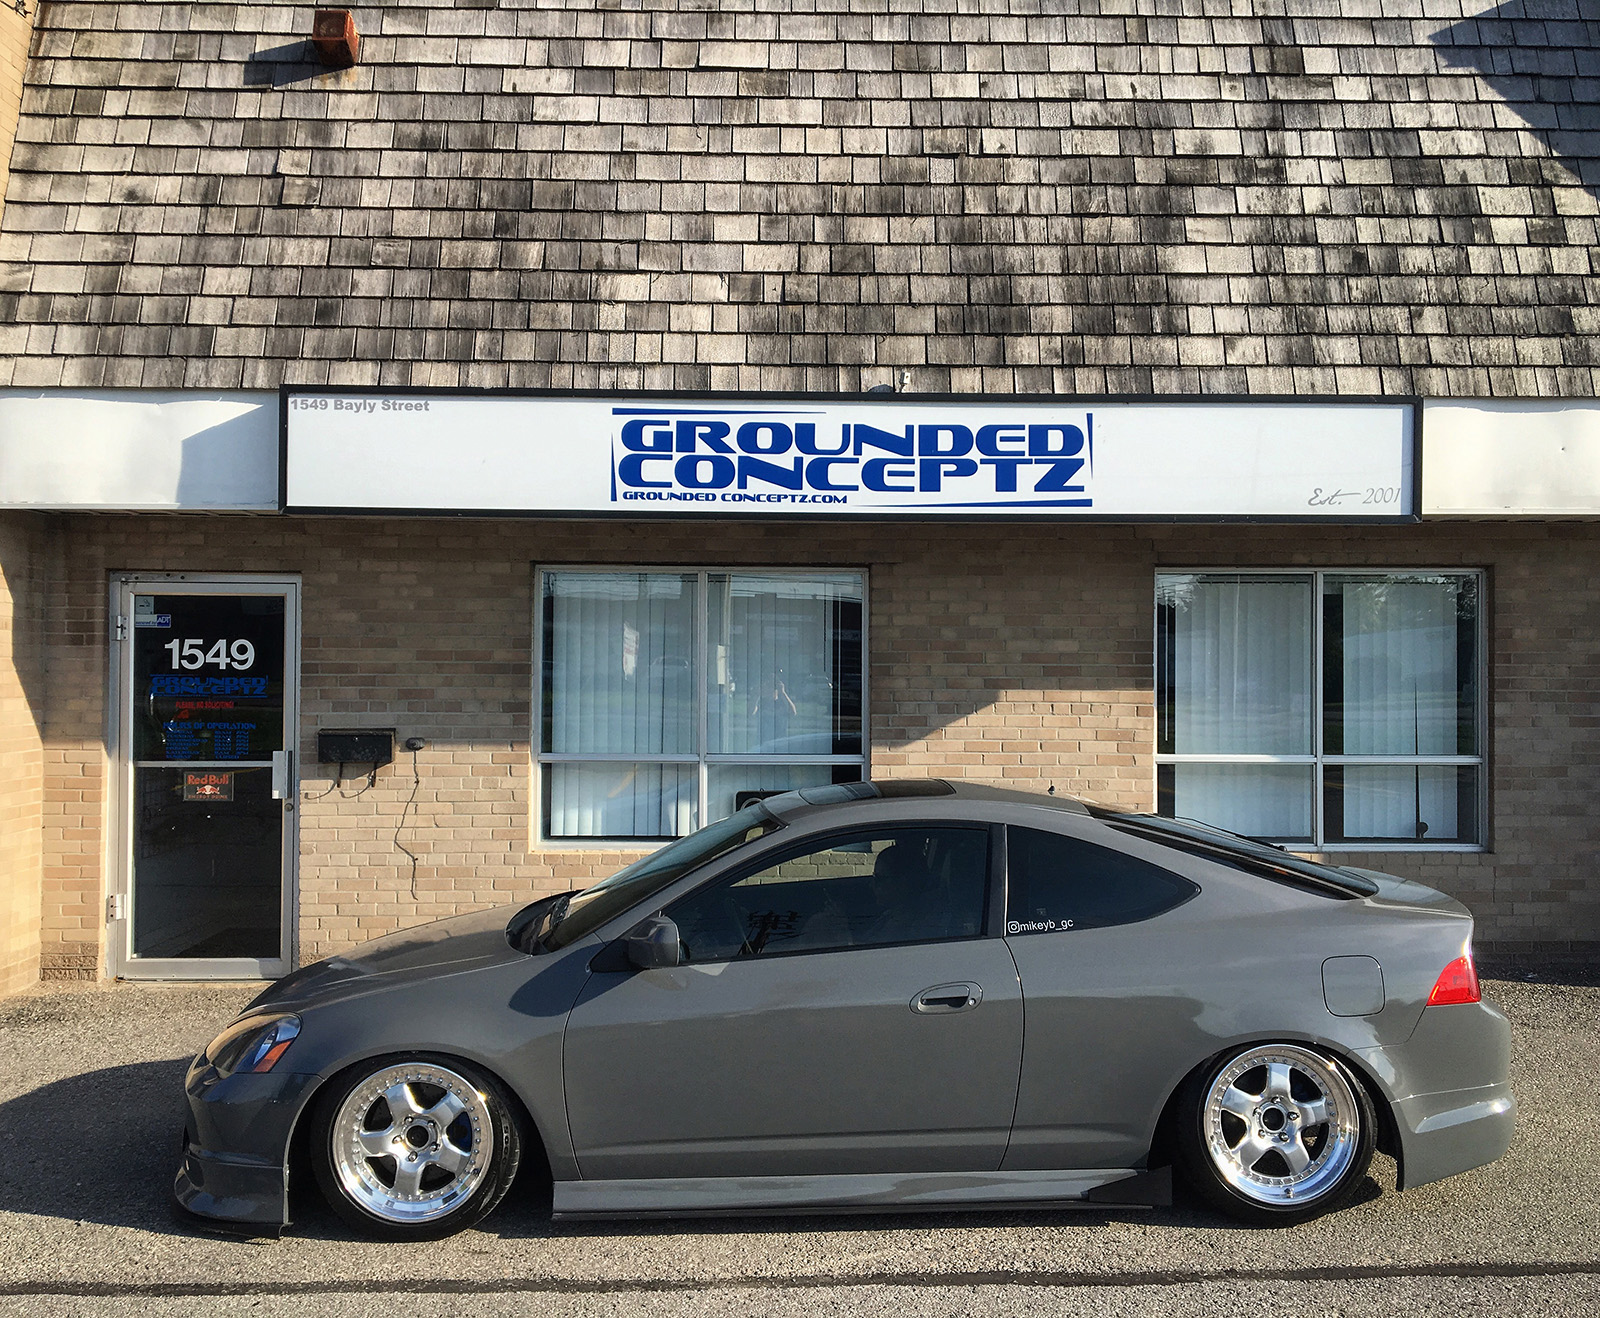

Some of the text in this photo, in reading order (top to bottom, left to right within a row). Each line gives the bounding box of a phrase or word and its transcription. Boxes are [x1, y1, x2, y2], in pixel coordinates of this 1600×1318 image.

[290, 399, 430, 413] 1549 Bayly Street
[621, 419, 1085, 457] GROUNDED
[618, 453, 1085, 493] CONCEPTZ
[622, 491, 848, 504] GROUNDED CONCEPTZ.COM
[1307, 487, 1401, 506] Est. 2001
[164, 638, 255, 670] 1549
[151, 676, 266, 686] GROUNDED
[150, 685, 266, 695] CONCEPTZ
[187, 774, 229, 784] Red Bull
[1020, 919, 1074, 932] mikeyb_gc
